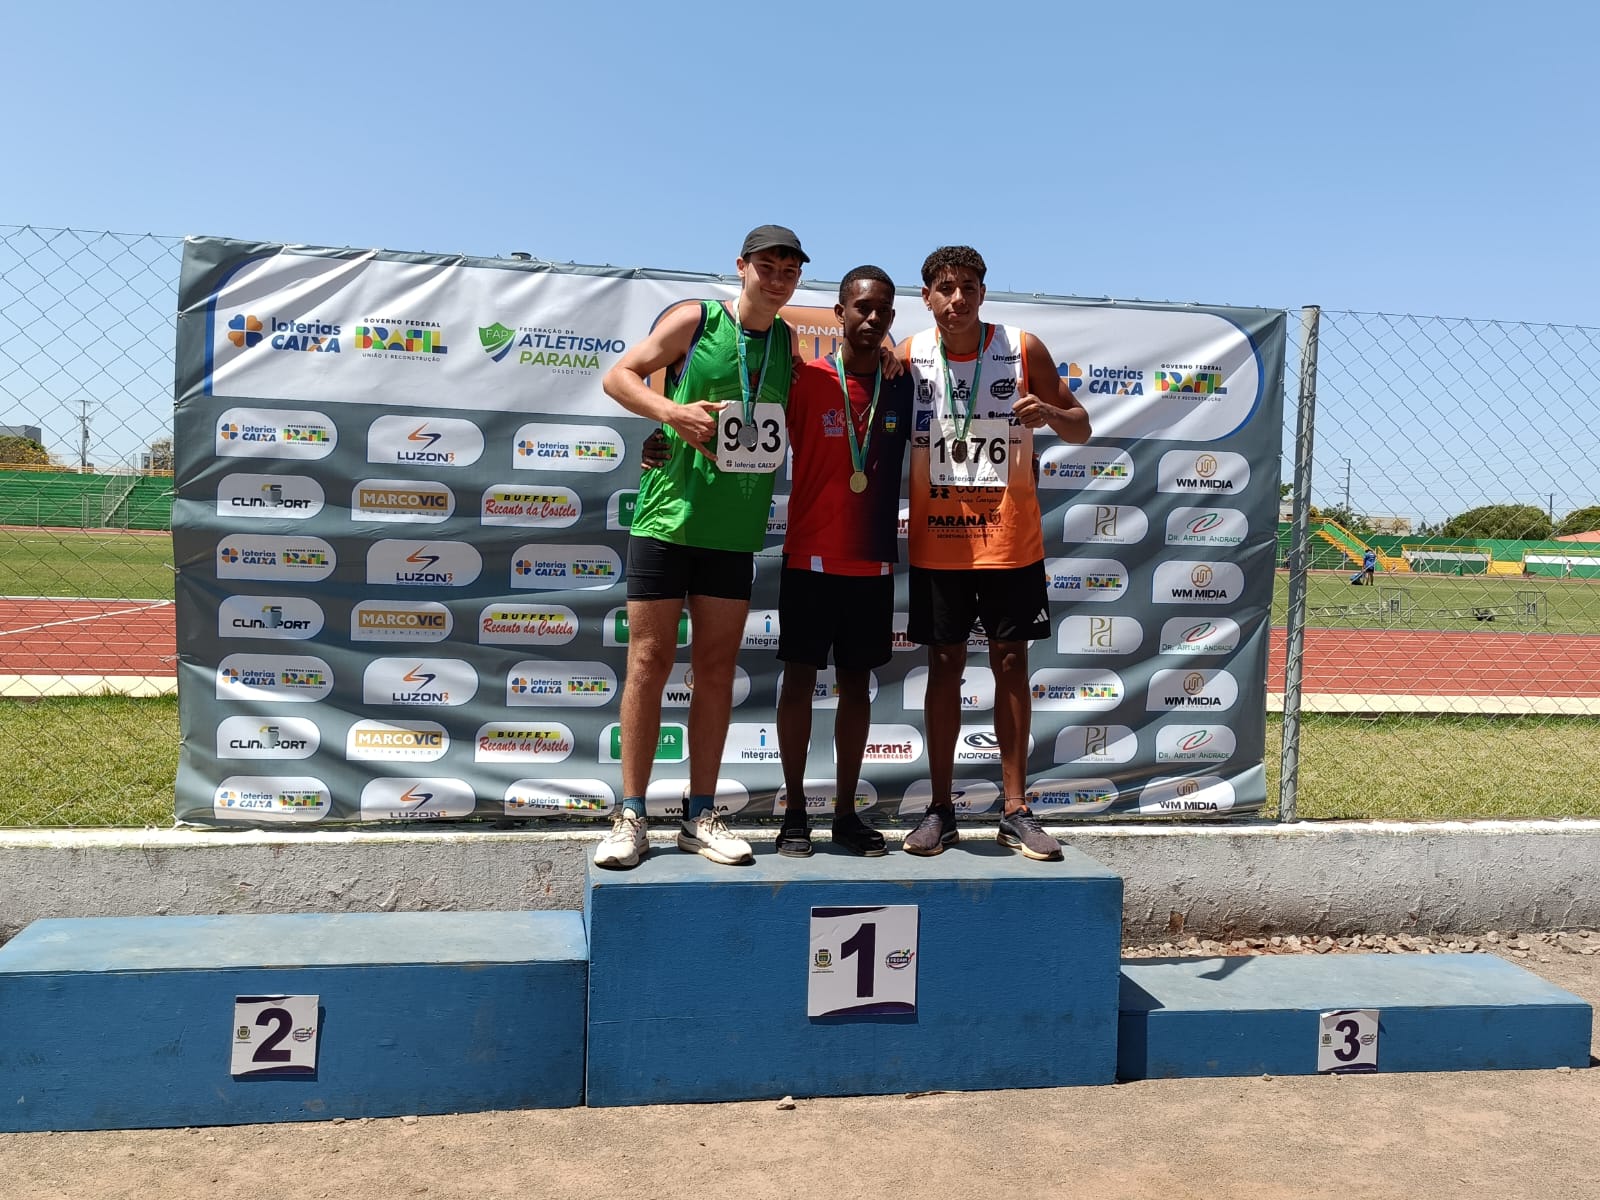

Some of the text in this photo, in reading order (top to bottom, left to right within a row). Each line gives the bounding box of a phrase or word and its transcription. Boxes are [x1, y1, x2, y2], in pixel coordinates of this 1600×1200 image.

[271, 317, 341, 336] loterias
[364, 317, 441, 328] GOVERNO FEDERAL
[486, 329, 509, 339] FAP
[271, 335, 341, 353] CAIXA
[518, 333, 626, 353] ATLETISMO
[519, 350, 600, 369] PARANÁ
[1089, 364, 1143, 380] loterias
[1088, 380, 1144, 396] CAIXA
[242, 424, 277, 433] loterias
[242, 433, 277, 442] CAIXA
[537, 441, 569, 450] loterias
[537, 449, 569, 458] CAIXA
[1059, 461, 1086, 470] loterias
[1059, 469, 1086, 478] CAIXA
[1176, 478, 1233, 489] WM MIDIA
[363, 493, 445, 507] MARCOVIC
[503, 494, 559, 502] BUFFET
[485, 499, 576, 518] Recanto da Costela
[928, 513, 987, 526] PARANÁ
[242, 549, 276, 557] loterias
[242, 556, 277, 565] CAIXA
[535, 560, 566, 568] loterias
[535, 568, 566, 577] CAIXA
[1053, 574, 1082, 582] loterias
[1053, 581, 1081, 589] CAIXA
[1172, 589, 1227, 599] WM MIDIA
[362, 614, 443, 627] MARCOVIC
[482, 617, 574, 636] Recanto da Costela
[746, 637, 778, 646] Integra
[242, 669, 276, 677] loterias
[242, 677, 276, 686] CAIXA
[530, 678, 562, 686] loterias
[530, 686, 562, 694] CAIXA
[666, 692, 690, 701] WM
[1048, 691, 1076, 699] CAIXA
[1164, 697, 1221, 706] WM MIDIA
[358, 733, 439, 745] MARCOVIC
[479, 736, 569, 754] Recanto da Costela
[866, 741, 912, 753] araná
[240, 792, 273, 800] loterias
[1160, 801, 1218, 810] WM MIDIA
[841, 923, 876, 998] 1
[252, 1007, 293, 1062] 2
[1334, 1019, 1361, 1061] 3
